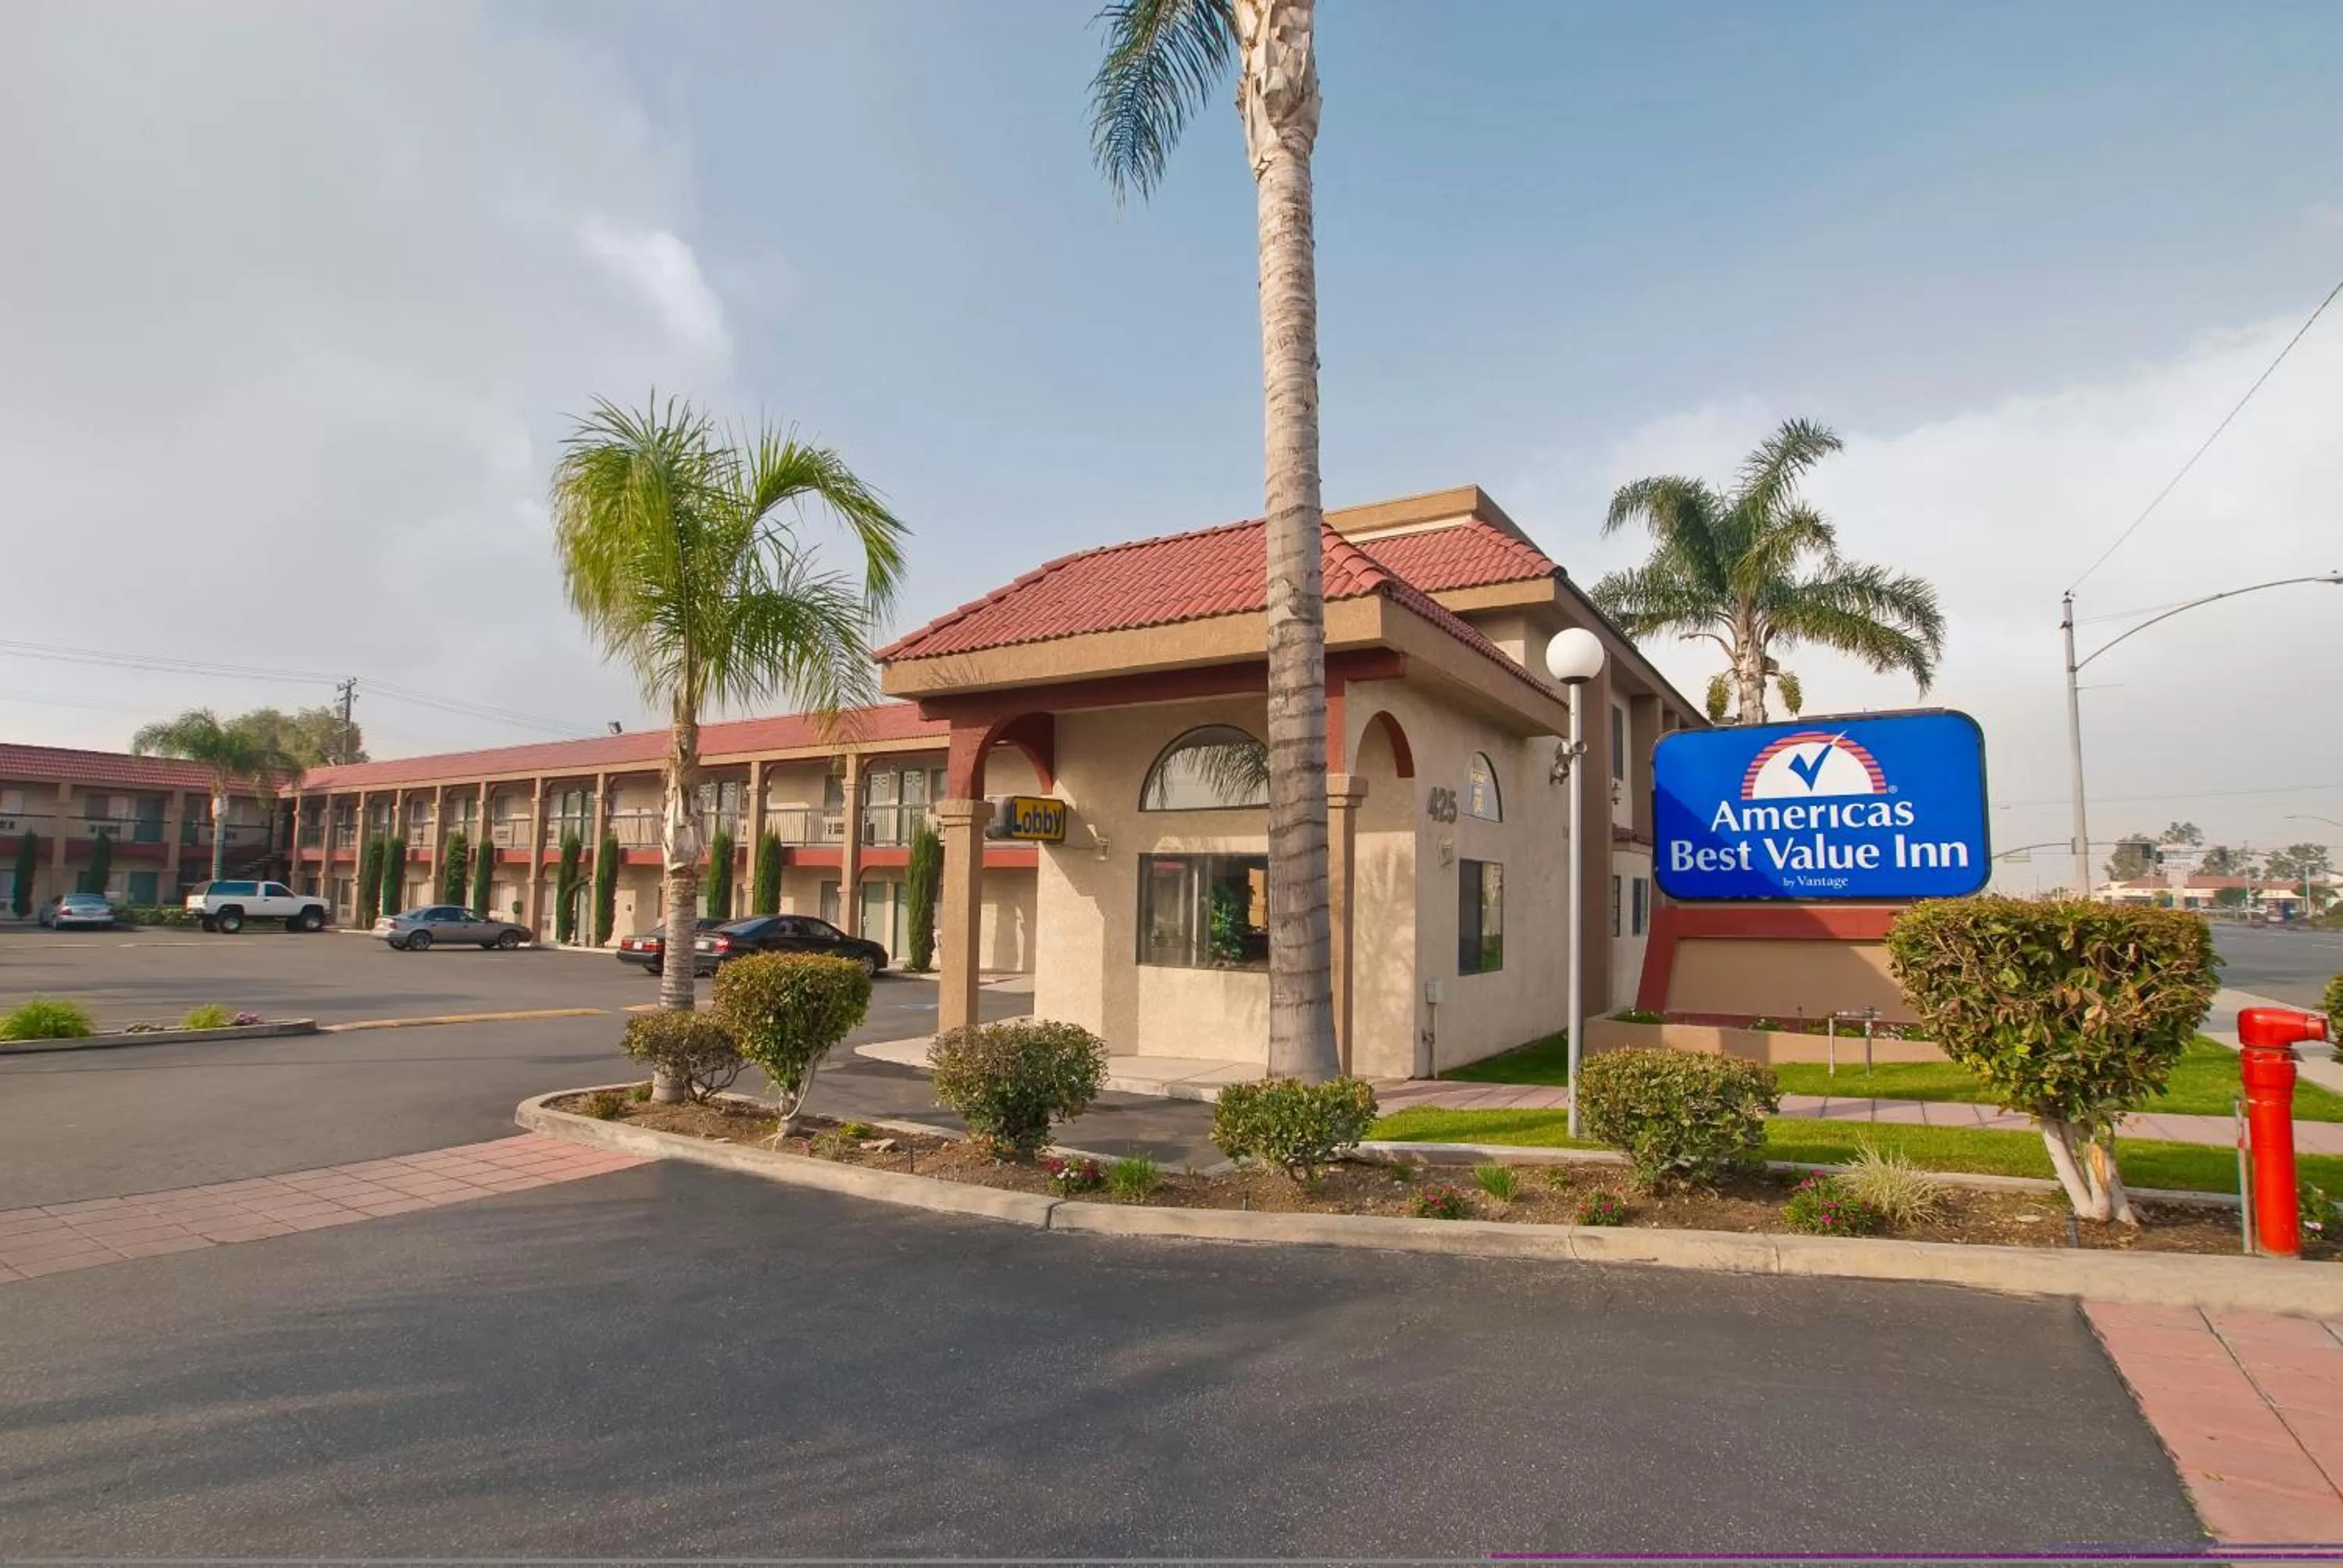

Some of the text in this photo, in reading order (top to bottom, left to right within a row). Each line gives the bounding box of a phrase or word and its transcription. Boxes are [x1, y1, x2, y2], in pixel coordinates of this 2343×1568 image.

[1011, 803, 1063, 836] Lobby
[1428, 787, 1457, 825] 425
[1710, 800, 1913, 832] Americas
[1671, 834, 1969, 871] Best Value Inn
[1783, 875, 1849, 888] by Vantage
